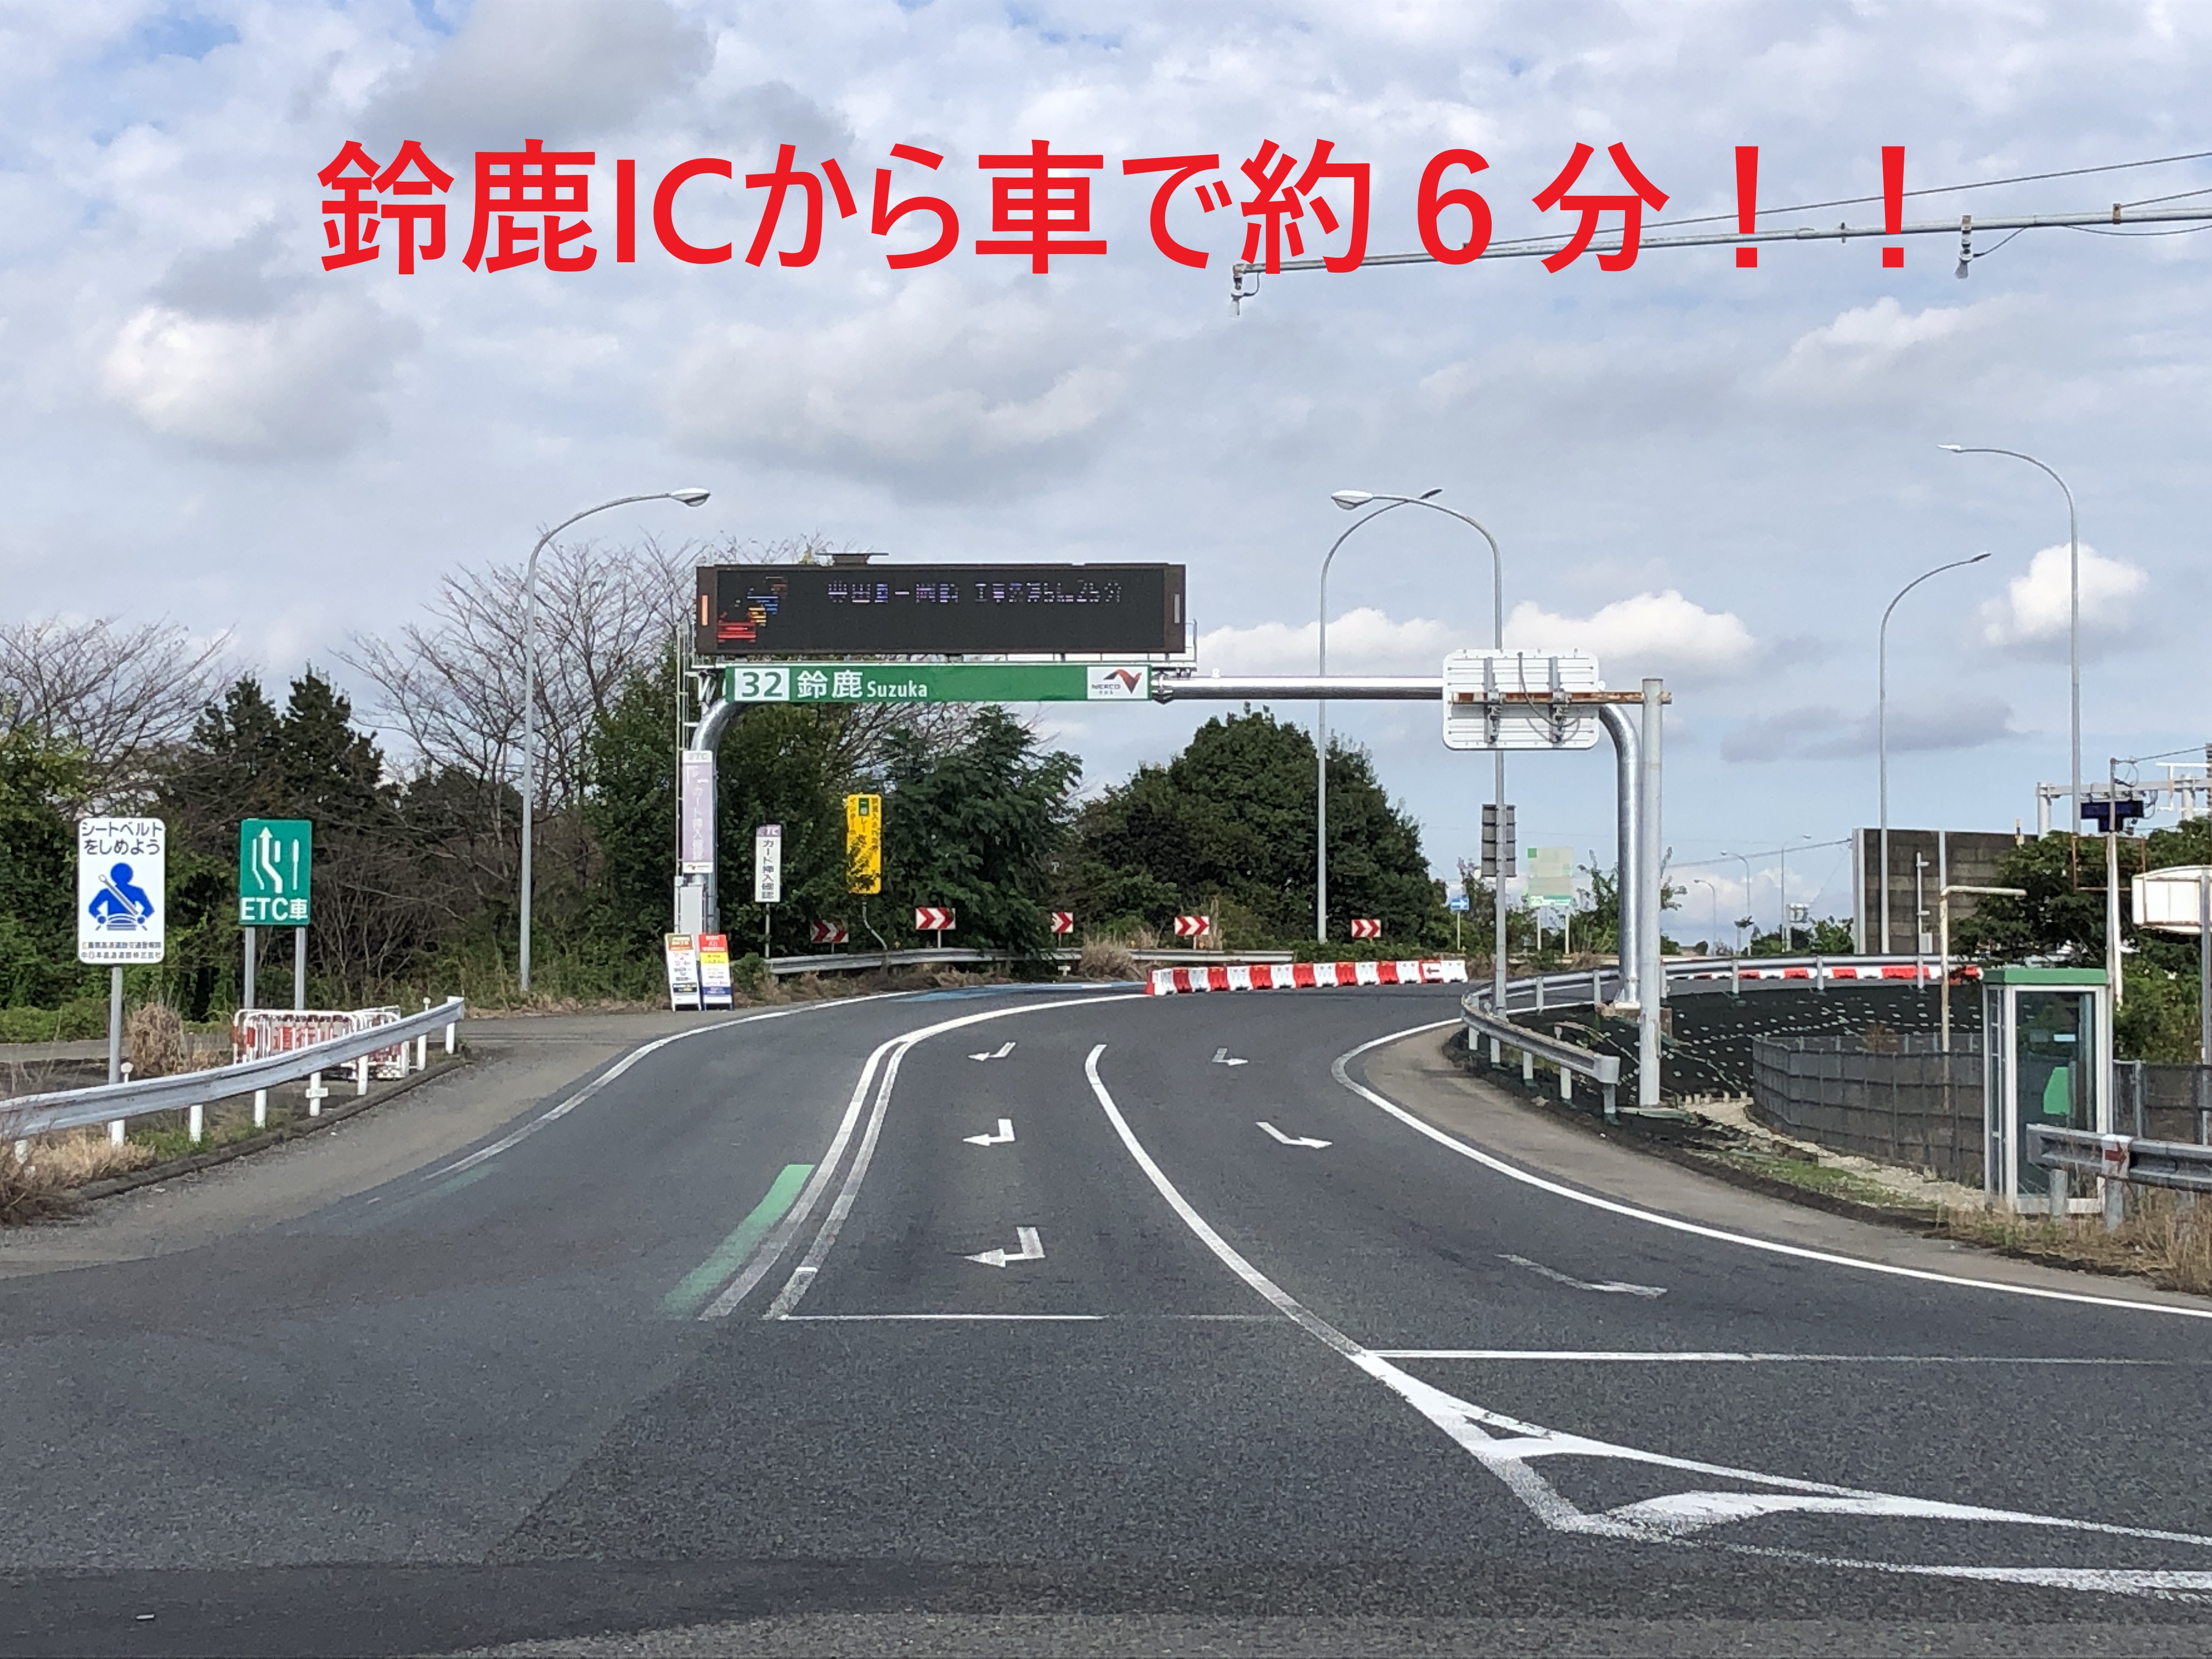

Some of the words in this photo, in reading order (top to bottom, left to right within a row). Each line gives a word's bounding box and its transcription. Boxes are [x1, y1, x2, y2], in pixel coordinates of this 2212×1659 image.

[742, 672, 783, 697] 32
[797, 669, 863, 698] 鈴鹿
[867, 680, 927, 697] Suzuka
[82, 822, 163, 837] シートベルト
[84, 839, 160, 855] をしめよう
[241, 898, 308, 921] ETC車
